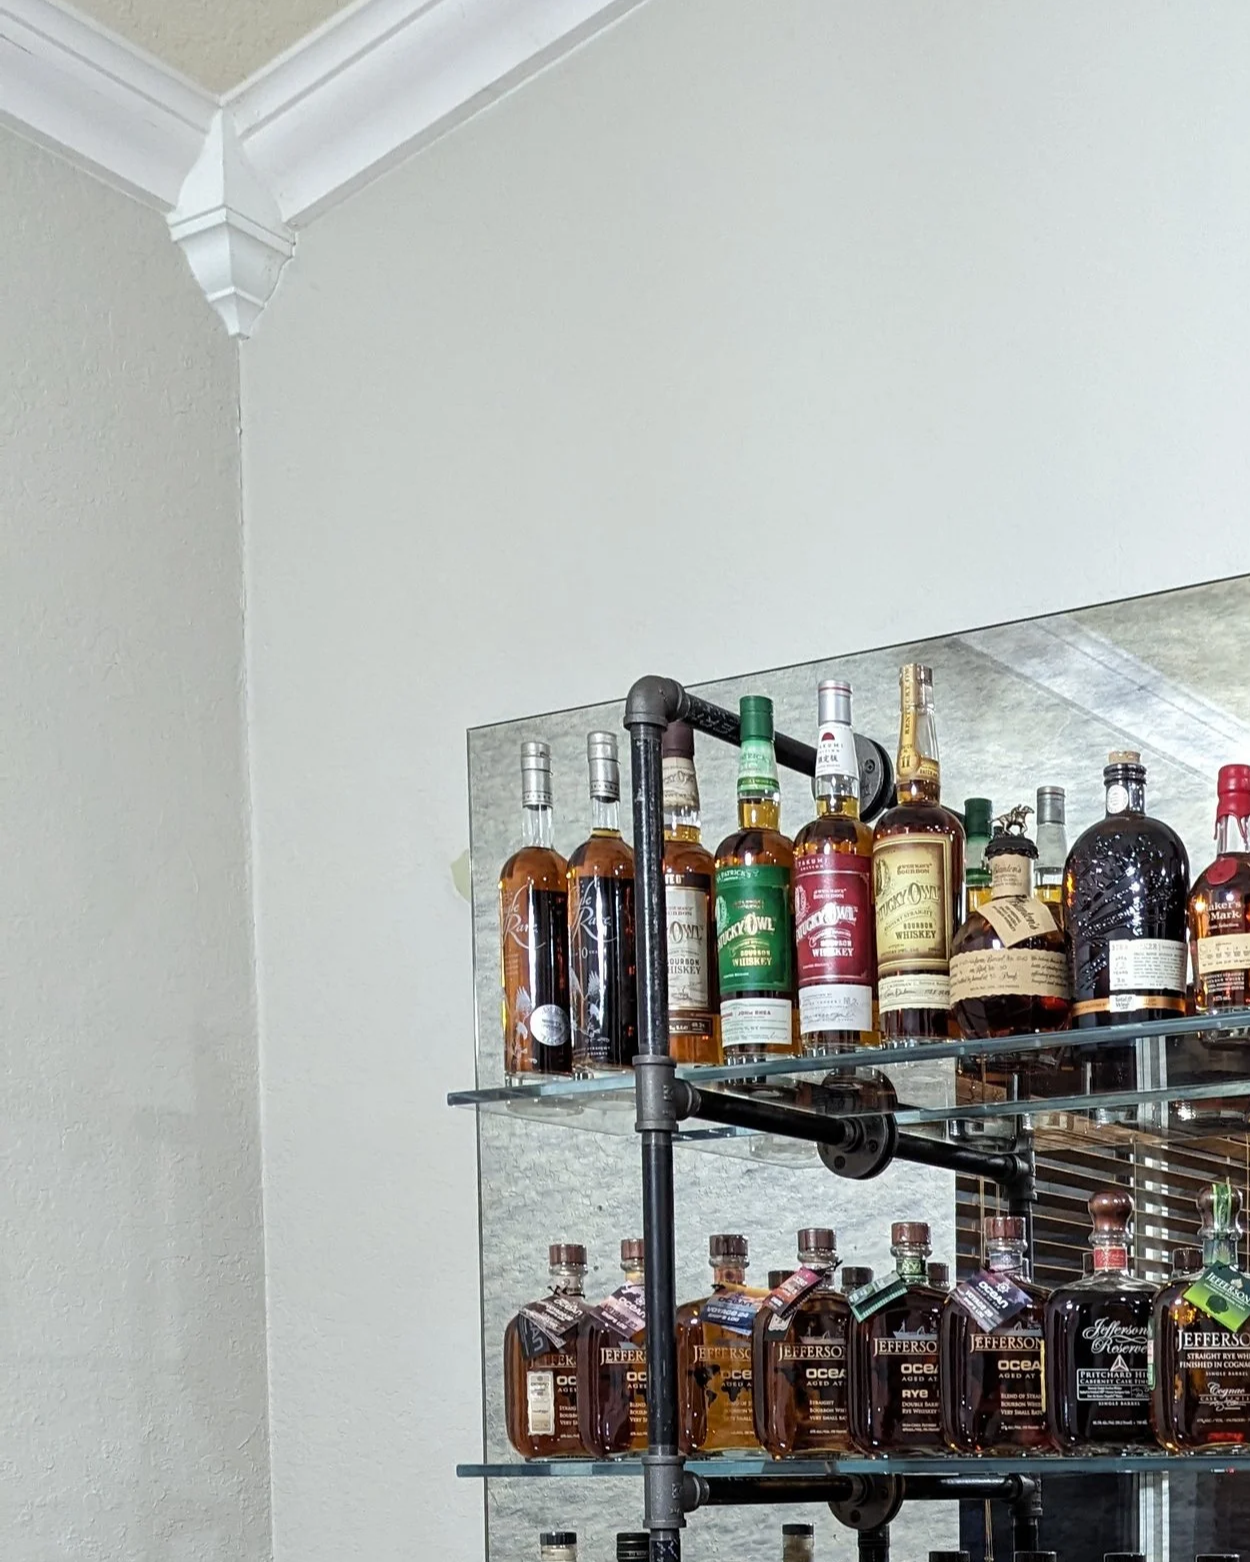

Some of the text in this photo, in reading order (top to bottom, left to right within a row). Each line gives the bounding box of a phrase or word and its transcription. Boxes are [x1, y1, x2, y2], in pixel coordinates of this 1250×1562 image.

[908, 883, 940, 904] OWL
[824, 902, 857, 926] OWL
[1210, 910, 1242, 921] Mark
[743, 911, 775, 936] OWL
[895, 930, 937, 940] WHISKEY
[1080, 1371, 1132, 1379] PRITCHARD
[902, 1389, 928, 1398] RYE
[1207, 1381, 1246, 1398] Cognac
